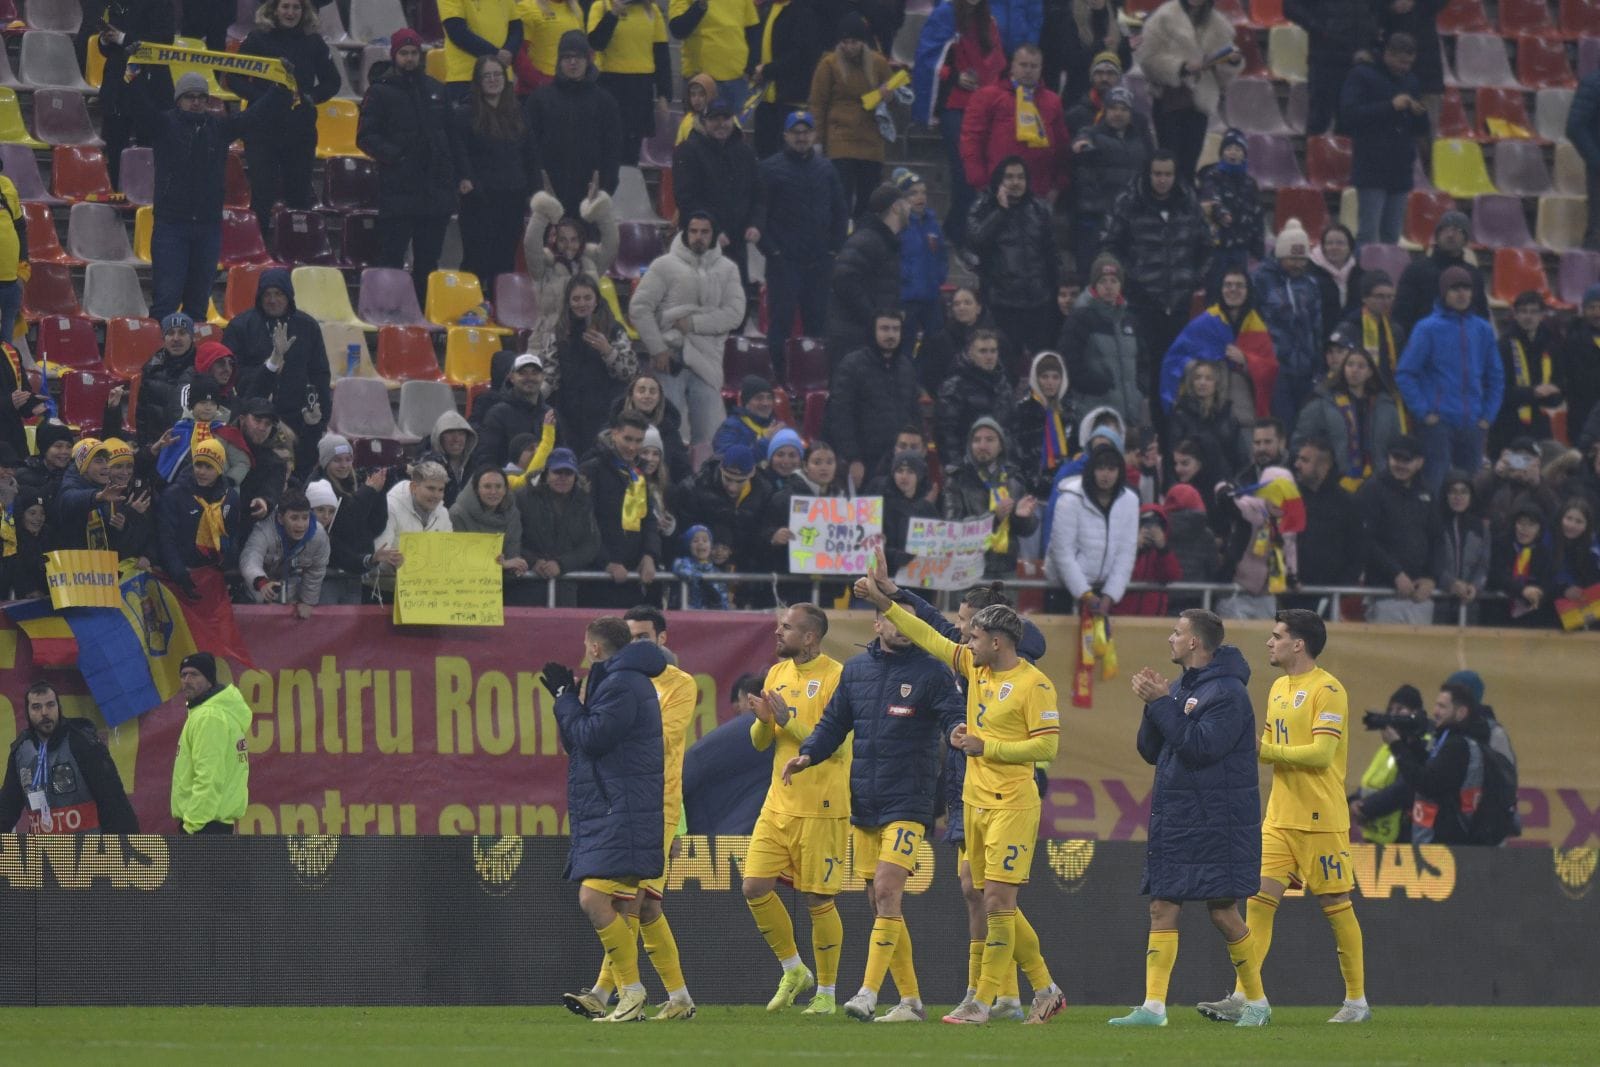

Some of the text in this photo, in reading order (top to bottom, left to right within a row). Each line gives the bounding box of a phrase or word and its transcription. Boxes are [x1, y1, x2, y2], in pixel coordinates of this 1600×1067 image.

[158, 50, 187, 62] HAI
[215, 655, 414, 755] entru
[976, 703, 986, 728] 2
[1275, 718, 1289, 745] 14
[893, 827, 916, 856] 15
[824, 857, 834, 882] 7
[1003, 845, 1019, 871] 2
[1319, 854, 1342, 880] 14
